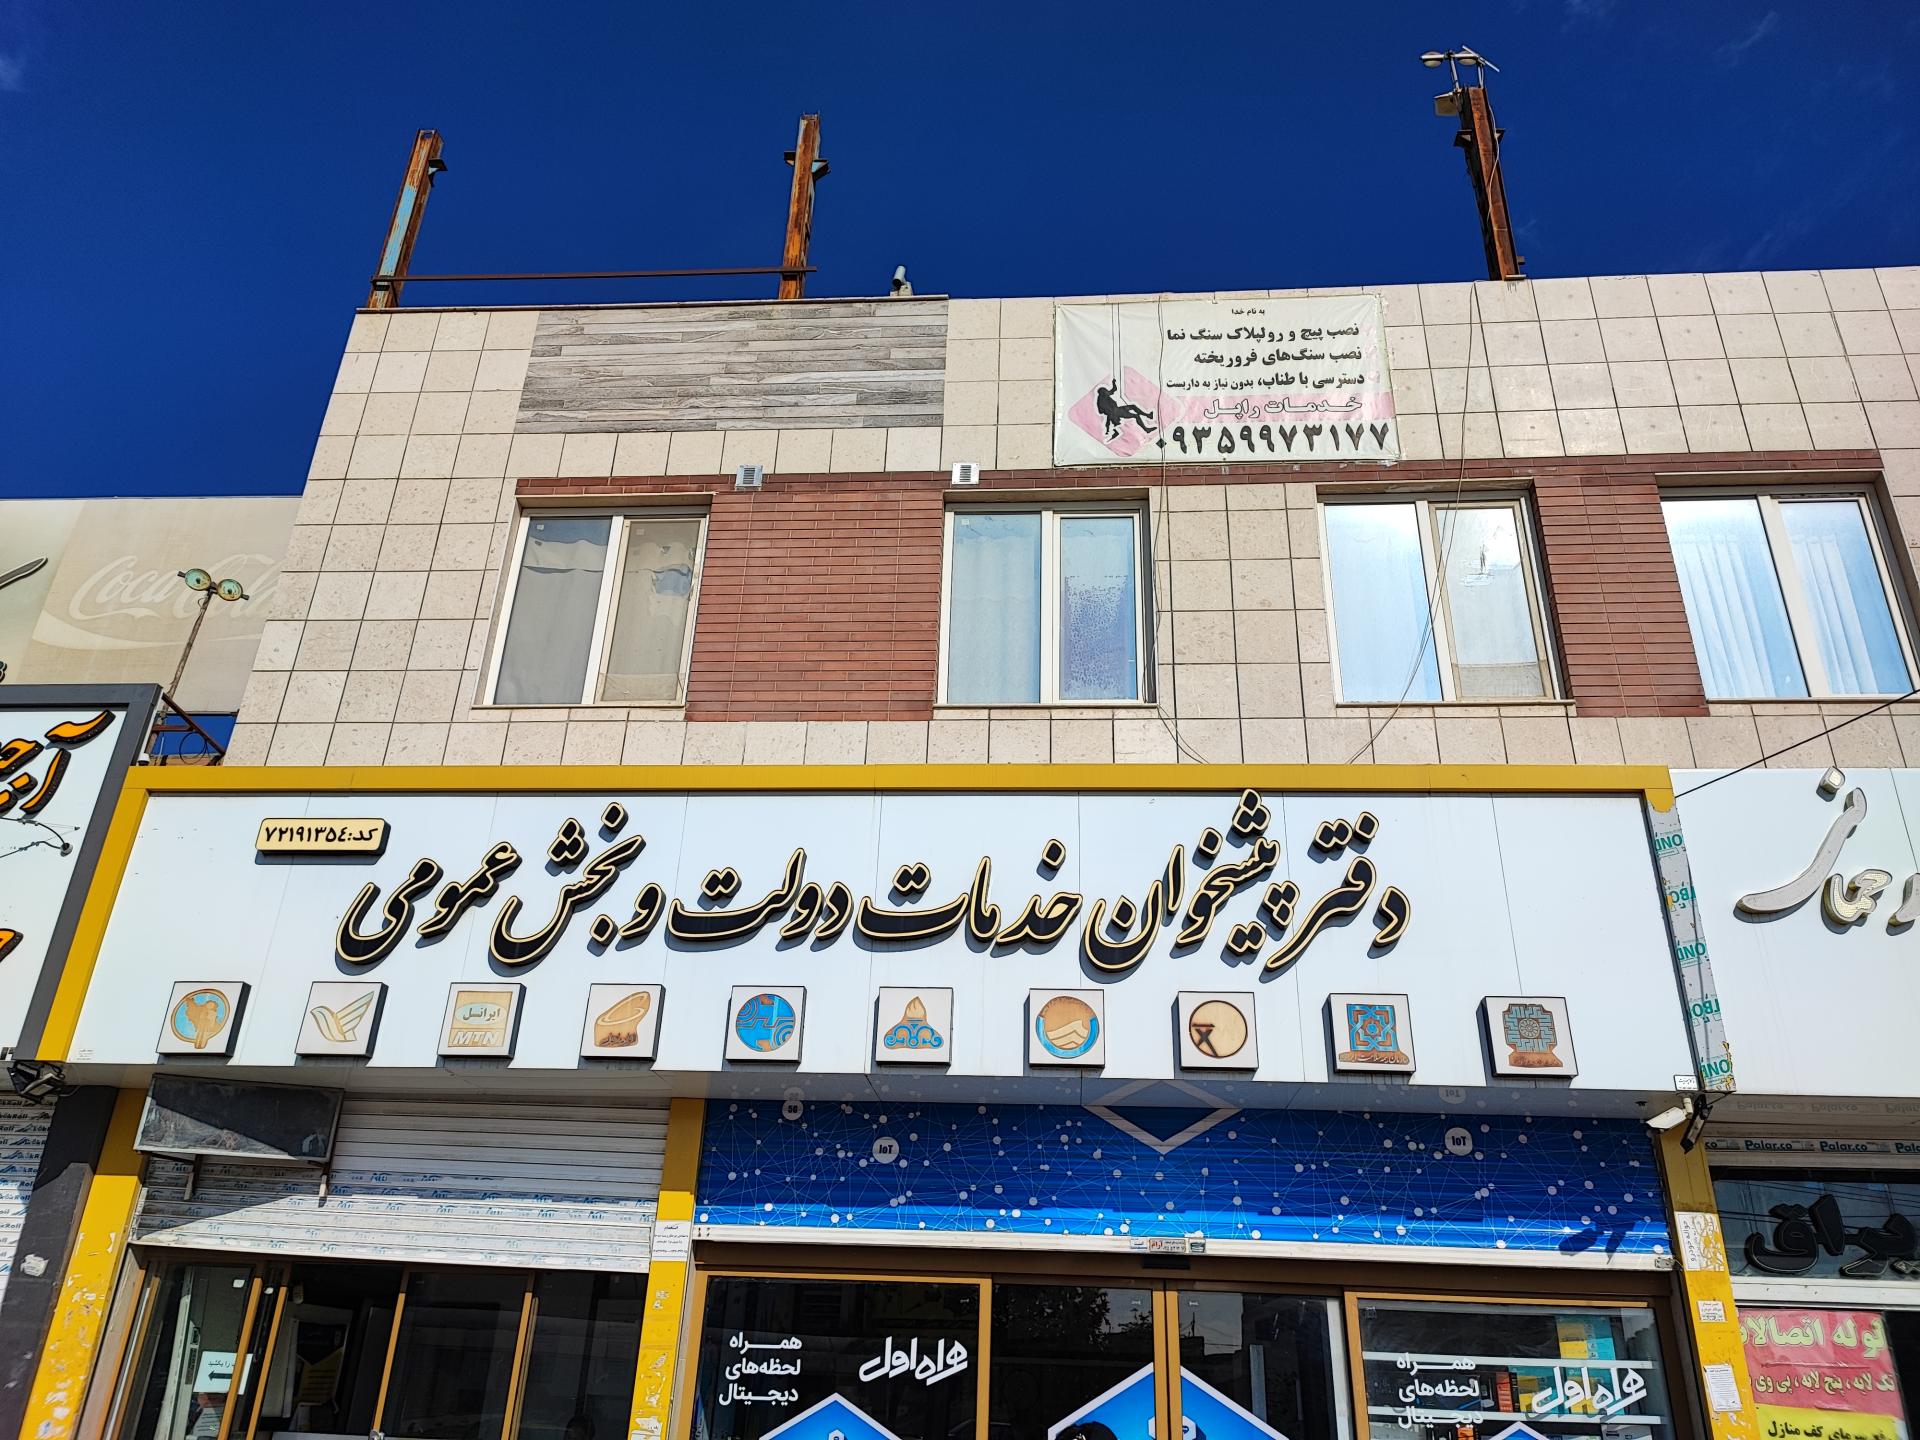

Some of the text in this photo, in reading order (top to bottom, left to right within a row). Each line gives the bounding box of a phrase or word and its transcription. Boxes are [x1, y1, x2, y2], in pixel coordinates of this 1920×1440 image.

[1231, 307, 1245, 315] خدا
[1166, 328, 1186, 341] نما
[1190, 328, 1222, 341] سنگ
[1289, 329, 1296, 342] و
[1300, 326, 1323, 342] پیچ
[1326, 323, 1360, 338] نصب
[1194, 348, 1258, 368] فروریخته
[1329, 347, 1362, 363] نصب
[1166, 378, 1200, 390] داربست
[1202, 380, 1211, 389] به
[1212, 378, 1228, 390] نیاز
[1230, 379, 1254, 390] بدون
[1298, 372, 1308, 389] با
[1312, 372, 1365, 389] دسترسی
[1204, 396, 1362, 419] خدمات راپل
[1156, 422, 1389, 455] ۰۹۳۵۹۹۷۳۱۷۷
[335, 788, 1411, 973] دفتر پیشخوان خدمات دولت و بخش عمومی
[462, 1007, 500, 1022] ایرانسل
[453, 1031, 500, 1046] MTN
[1452, 1136, 1466, 1146] IoT
[1744, 1140, 1793, 1151] Palar.co
[1819, 1141, 1868, 1152] Palar.co
[878, 1144, 894, 1154] IoT
[729, 1332, 802, 1354] همراه
[1832, 1317, 1888, 1359] لوله
[1396, 1352, 1476, 1376] همراه
[718, 1383, 799, 1406] دیجیتال
[1397, 1406, 1484, 1430] دیجیتال
[1768, 1420, 1801, 1438] منازل
[1804, 1424, 1824, 1437] کف
